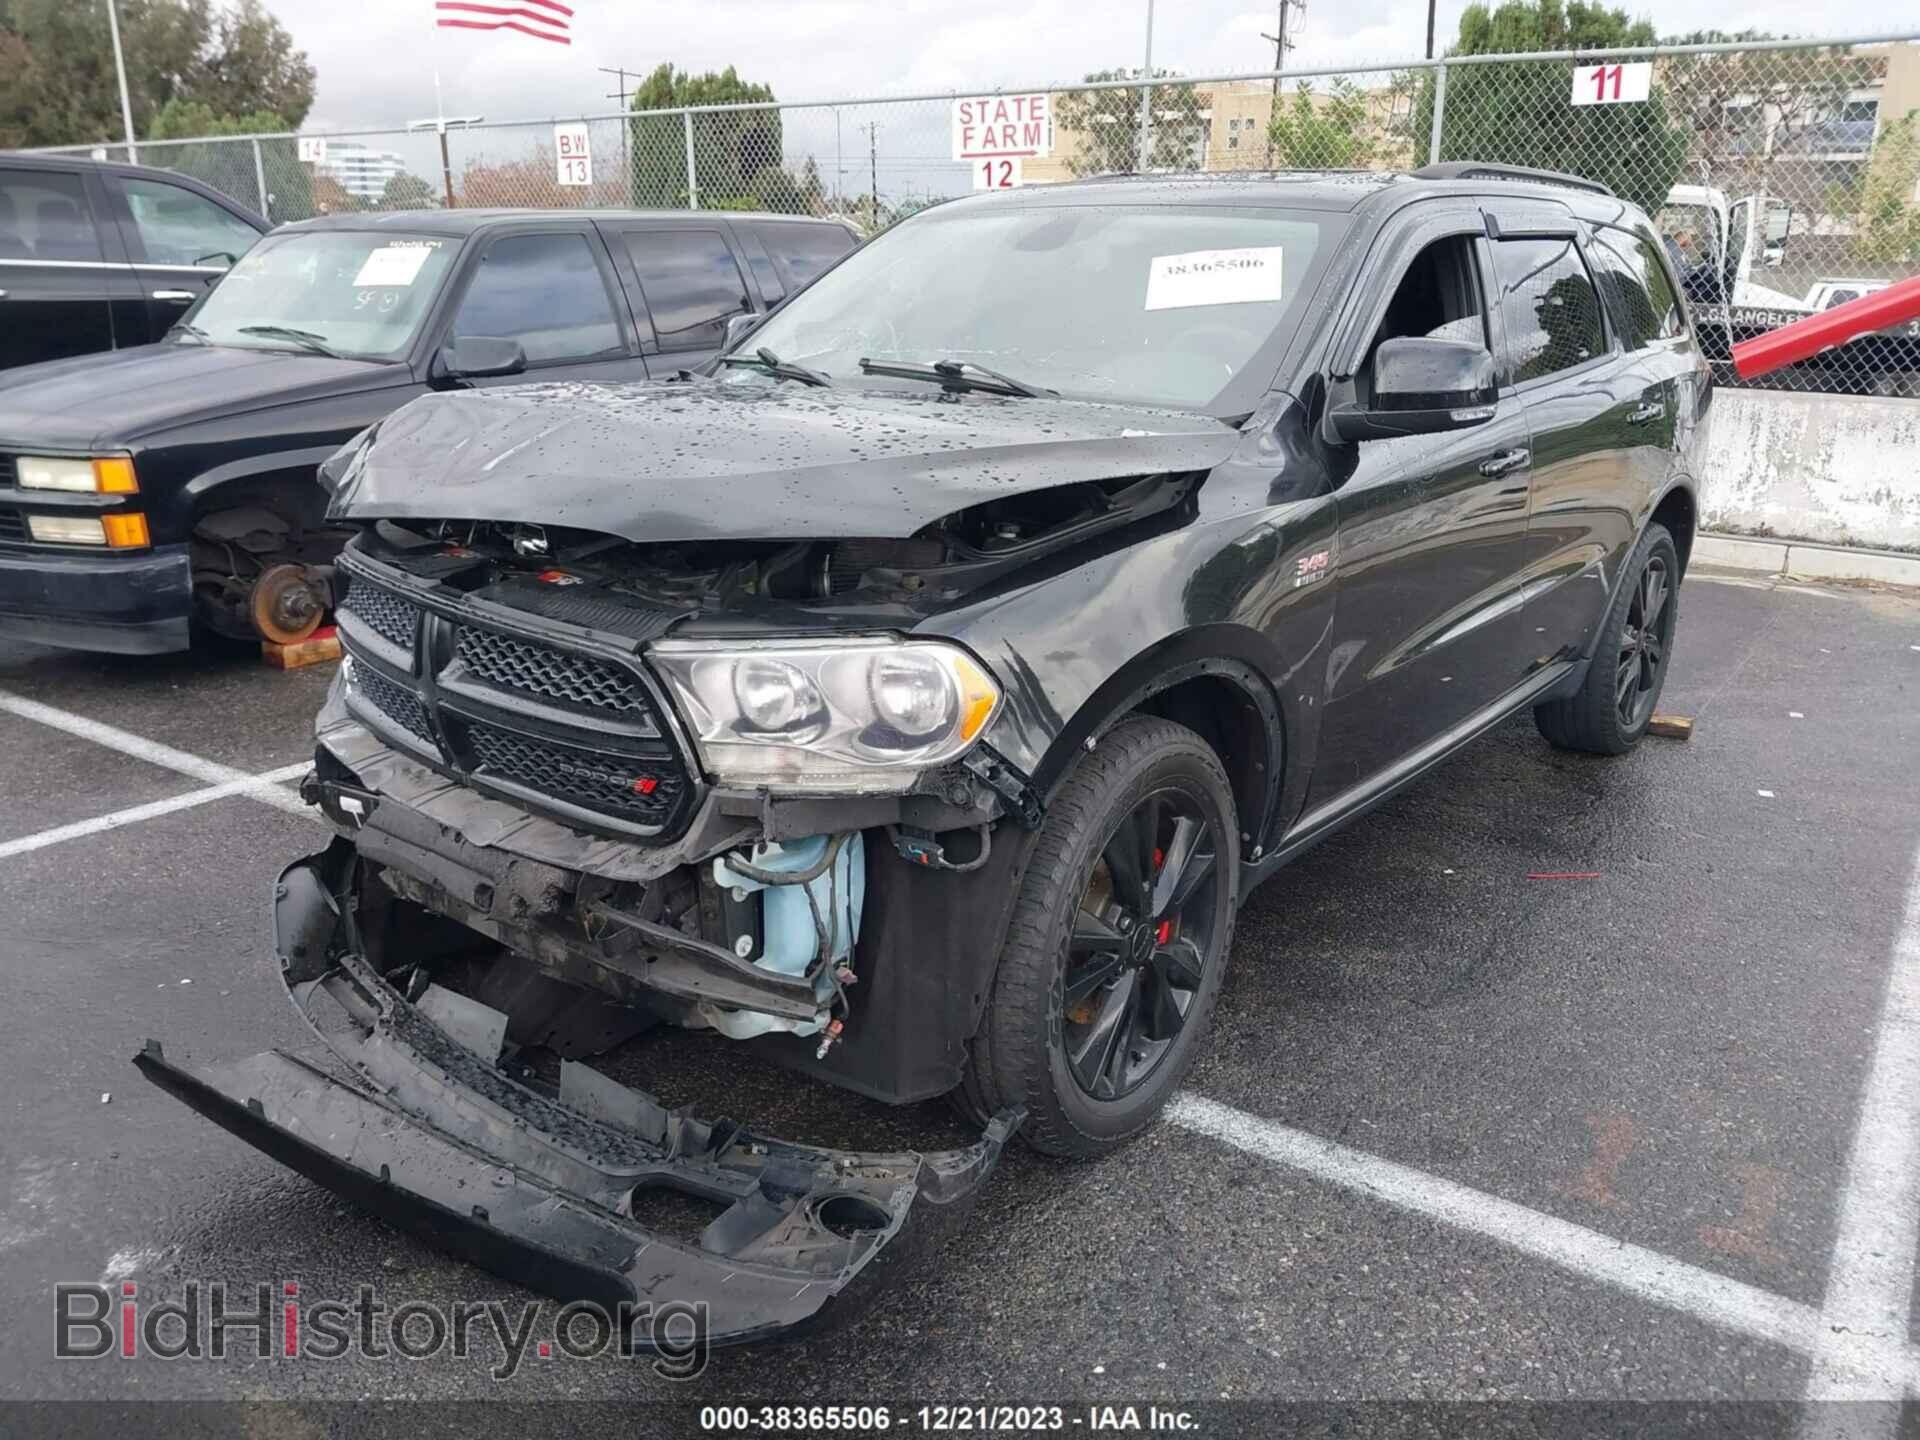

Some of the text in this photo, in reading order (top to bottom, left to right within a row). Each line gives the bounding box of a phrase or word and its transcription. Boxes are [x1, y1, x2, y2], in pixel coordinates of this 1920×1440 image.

[1590, 64, 1623, 101] 11
[959, 96, 1045, 125] STATE
[559, 134, 586, 154] BW
[963, 122, 1042, 151] FARM
[565, 160, 587, 182] 13
[981, 160, 1014, 188] 12
